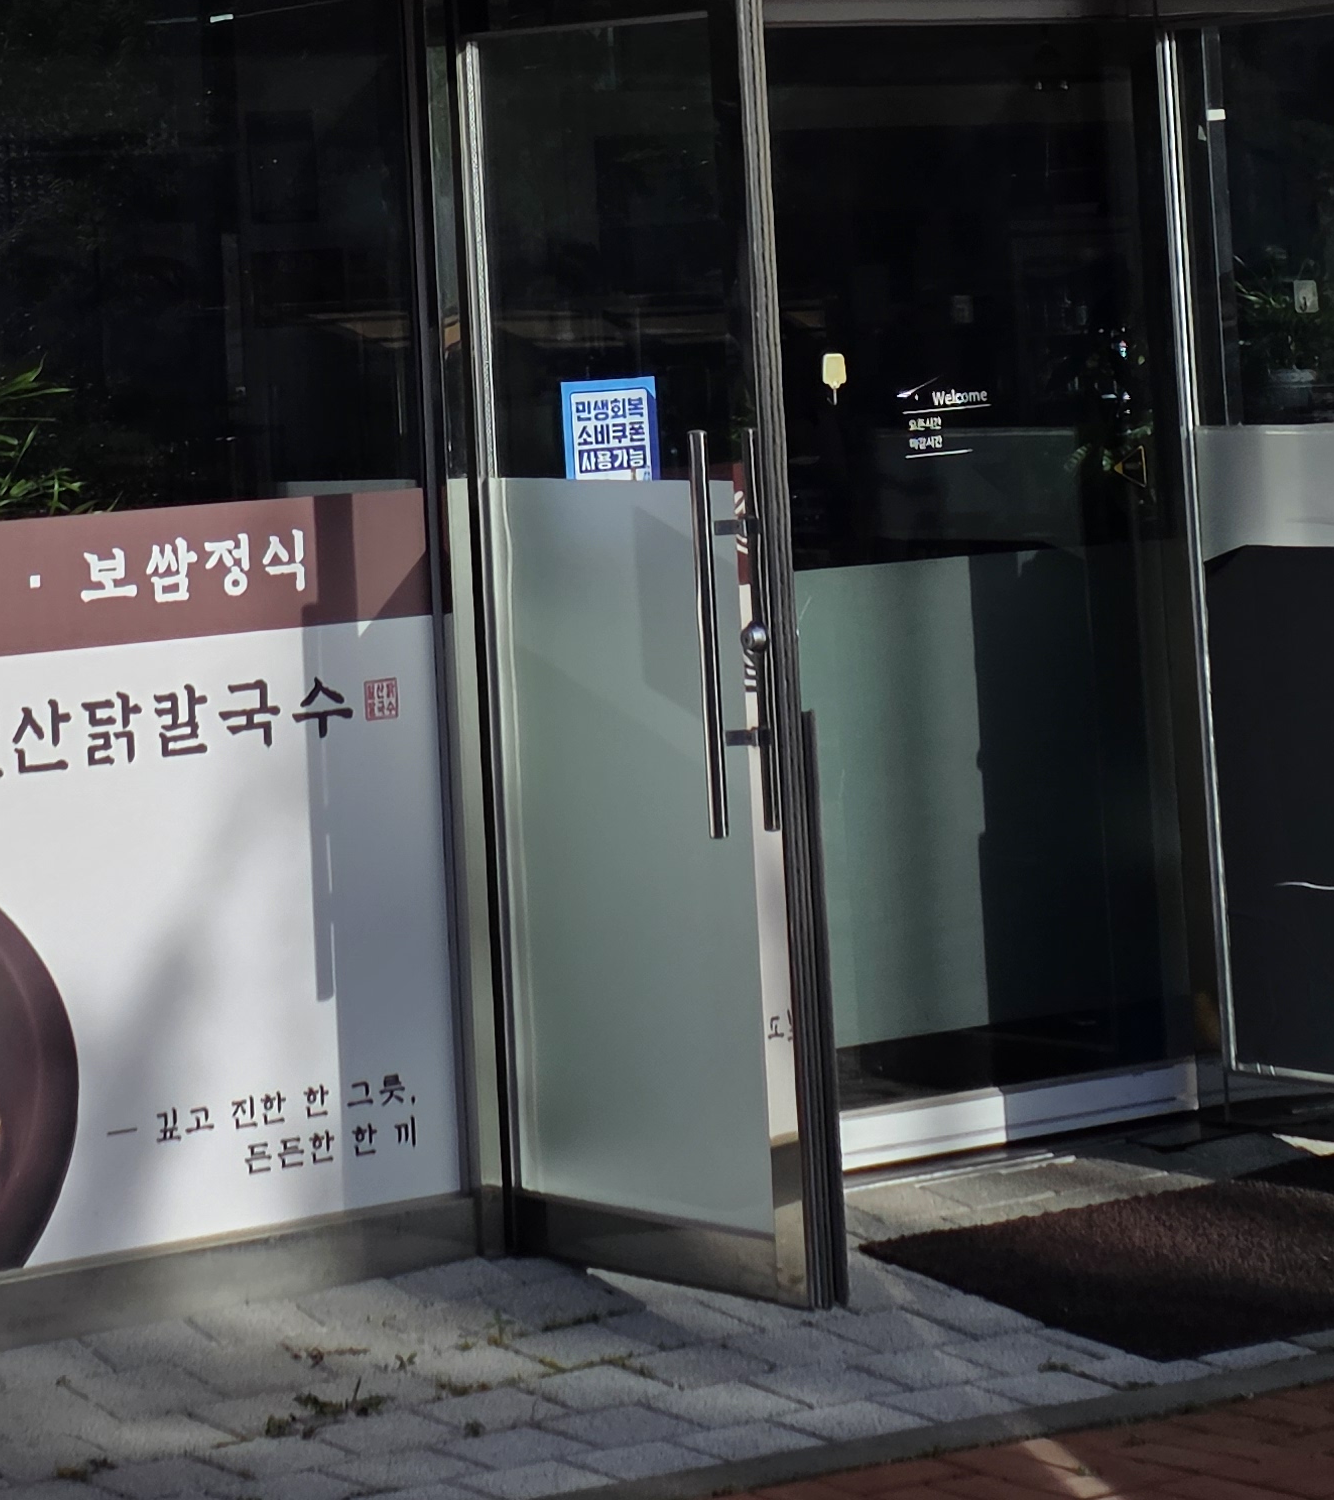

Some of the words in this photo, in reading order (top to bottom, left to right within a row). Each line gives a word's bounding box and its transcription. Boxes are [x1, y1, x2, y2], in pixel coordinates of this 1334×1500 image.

[575, 396, 645, 422] 민생회복
[931, 388, 988, 406] Welcome
[577, 421, 646, 447] 소비쿠폰
[581, 447, 645, 472] 사용가능
[80, 528, 307, 604] 보쌈정식
[155, 1107, 215, 1144] 깊고
[231, 1090, 287, 1131] 진한
[303, 1083, 330, 1119] 한
[244, 1129, 335, 1176] 든든한
[351, 1122, 378, 1157] 한
[394, 1114, 417, 1149] 끼
